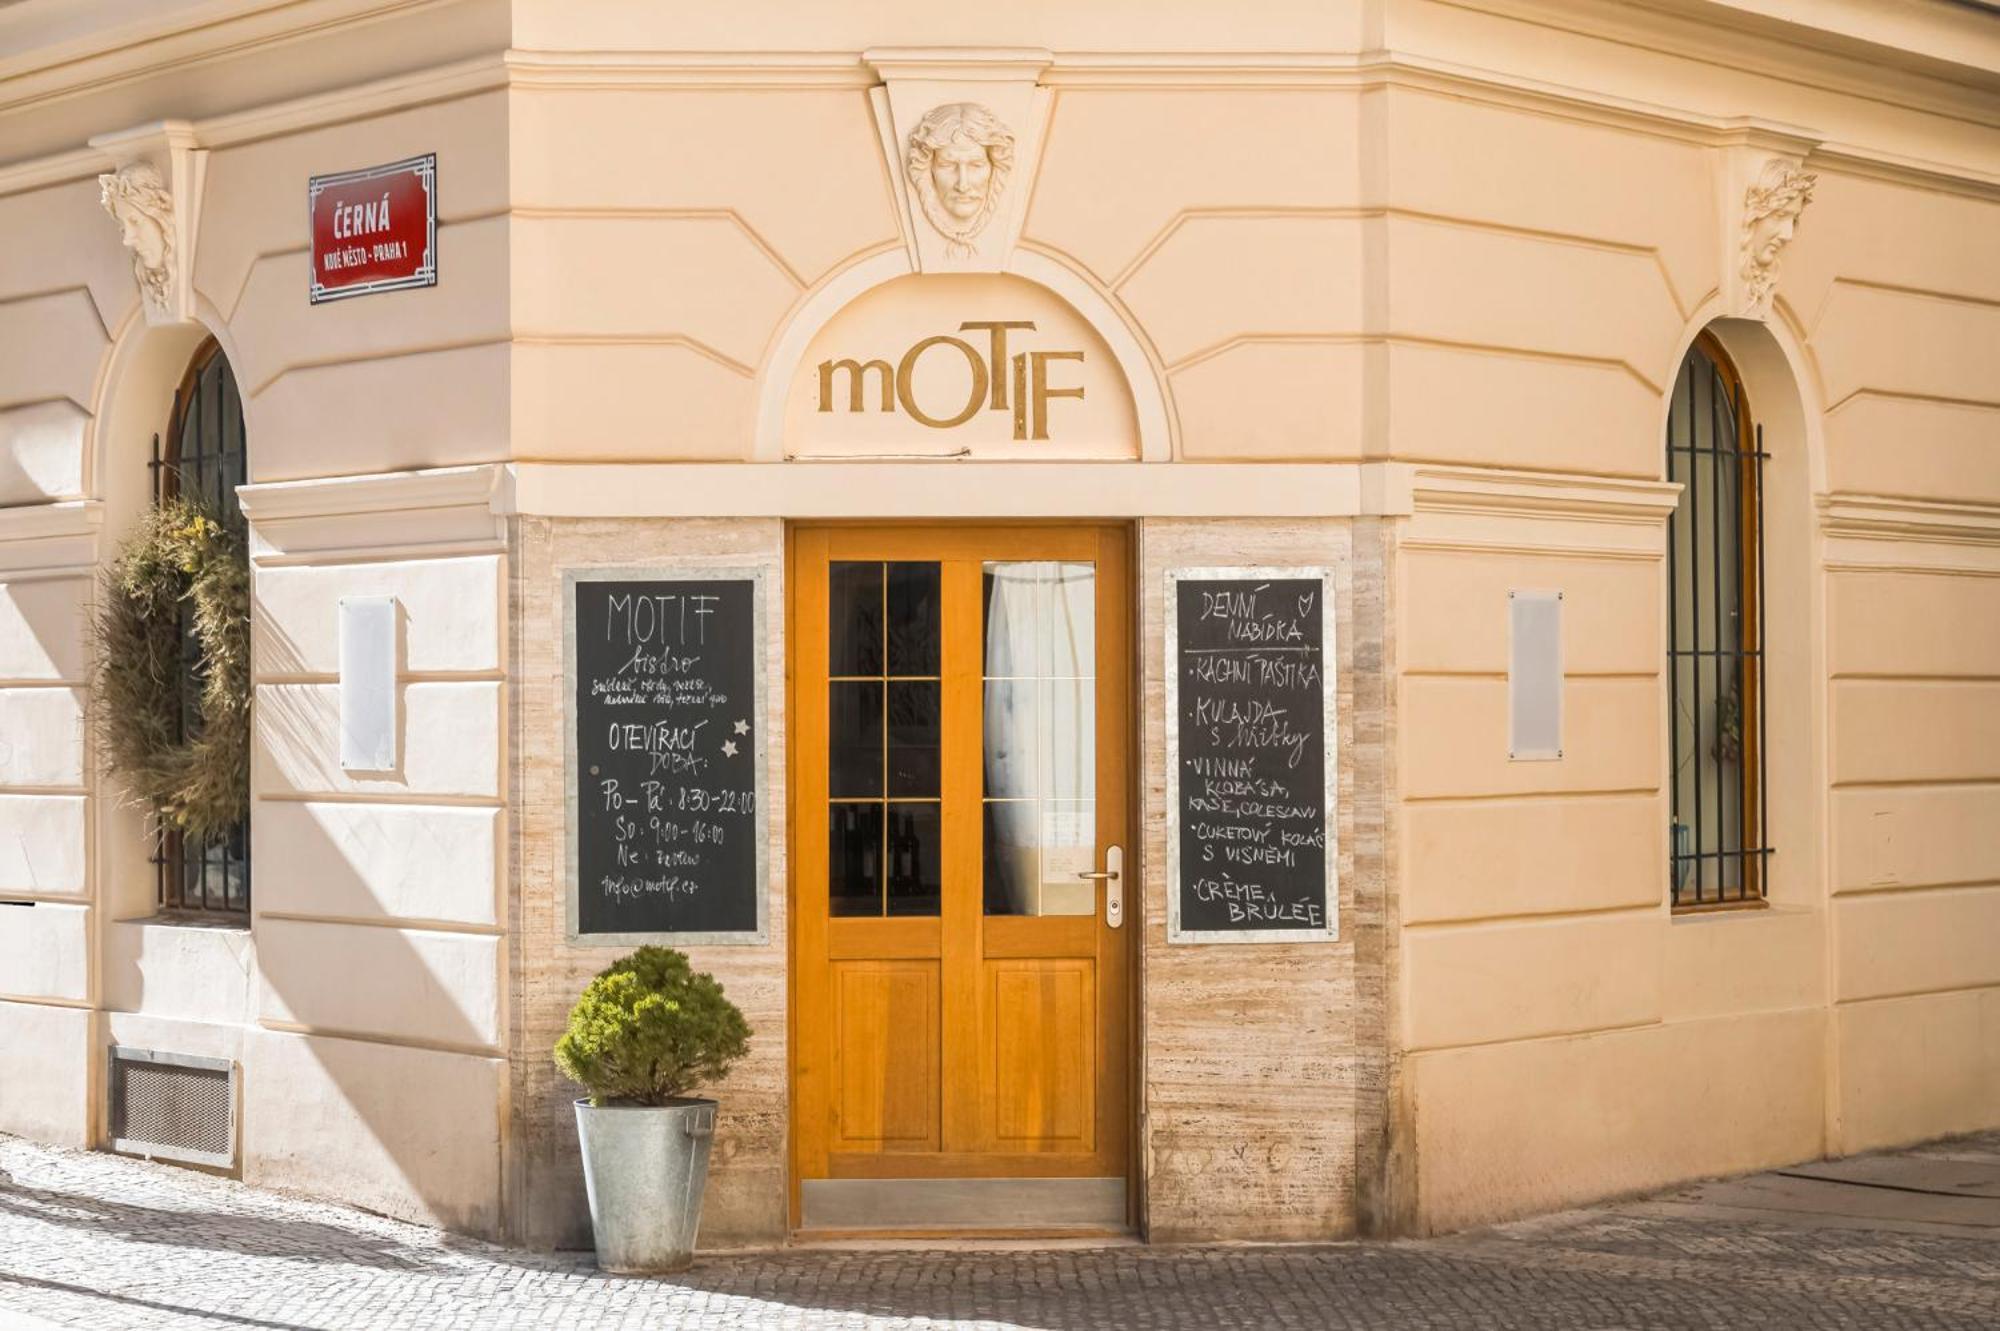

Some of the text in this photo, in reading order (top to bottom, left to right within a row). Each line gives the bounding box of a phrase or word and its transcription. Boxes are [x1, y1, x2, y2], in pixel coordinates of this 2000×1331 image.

[334, 192, 390, 239] ČERNÁ
[343, 245, 367, 267] MĚSTO
[373, 242, 401, 261] PRAHA
[401, 241, 407, 257] 1
[1201, 584, 1270, 620] DENNÍ
[608, 594, 720, 645] MOTIF
[1228, 613, 1304, 642] NABÍDKA
[1197, 654, 1260, 684] KACHNÍ
[1197, 697, 1287, 727] KULAJDA
[609, 720, 709, 750] OTEVÍRACÍ
[650, 752, 708, 776] DOBA:
[1192, 757, 1255, 778] VINNÁ
[1240, 801, 1317, 819] COLESLAW
[1197, 822, 1272, 844] CUKETOVÝ
[1197, 872, 1266, 901] CRÈME
